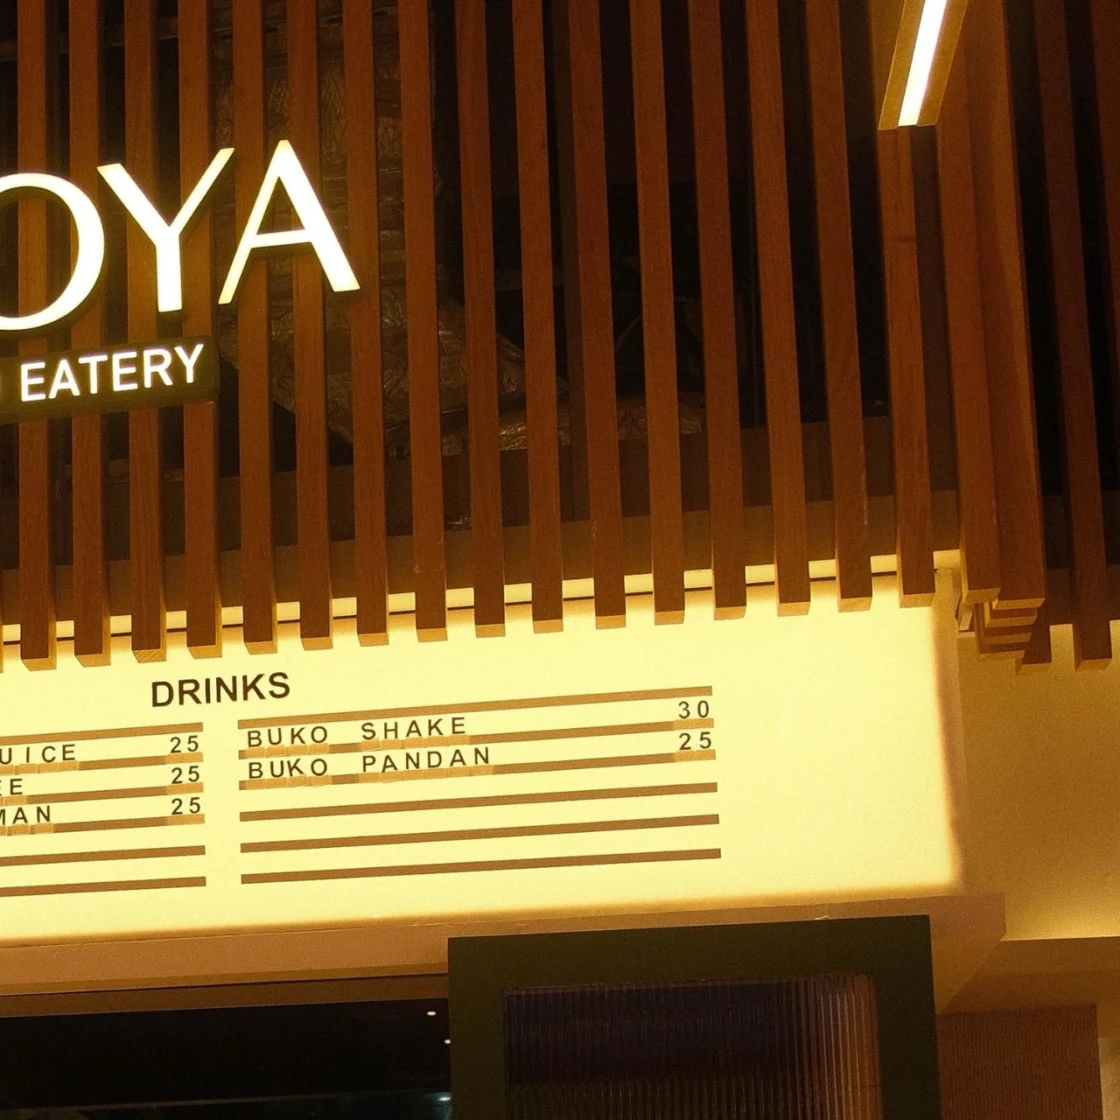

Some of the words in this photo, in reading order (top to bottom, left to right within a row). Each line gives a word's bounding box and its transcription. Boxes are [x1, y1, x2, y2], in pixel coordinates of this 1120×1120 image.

[20, 343, 204, 402] EATERY
[151, 671, 290, 708] DRINKS
[678, 700, 711, 720] 30
[247, 726, 328, 748] BUKO
[361, 717, 466, 740] SHAKE
[679, 731, 713, 751] 25
[170, 735, 200, 754] 25
[248, 758, 328, 779] BUKO
[362, 747, 489, 773] PANDAN
[171, 765, 201, 786] 25
[171, 796, 202, 816] 25
